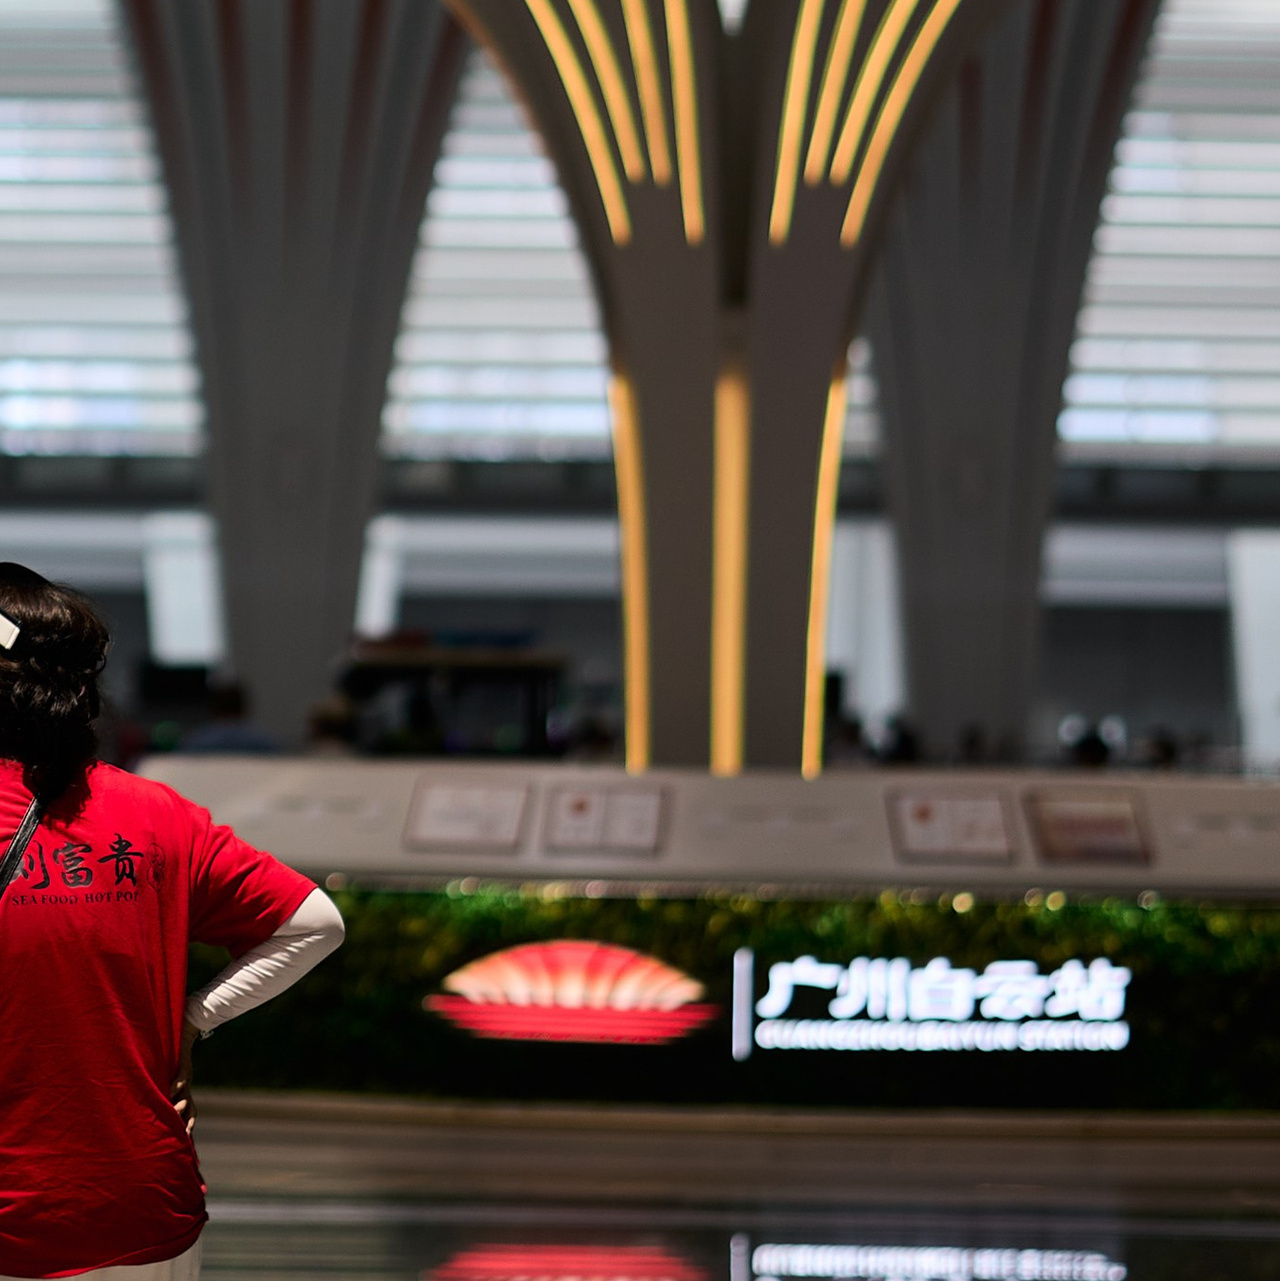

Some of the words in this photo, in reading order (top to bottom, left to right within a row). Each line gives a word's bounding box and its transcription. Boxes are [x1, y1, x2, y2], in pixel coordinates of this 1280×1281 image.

[12, 894, 37, 907] SEA
[41, 893, 79, 907] FOOD
[85, 891, 112, 904] HOT
[755, 955, 1132, 1021] 广州白云站
